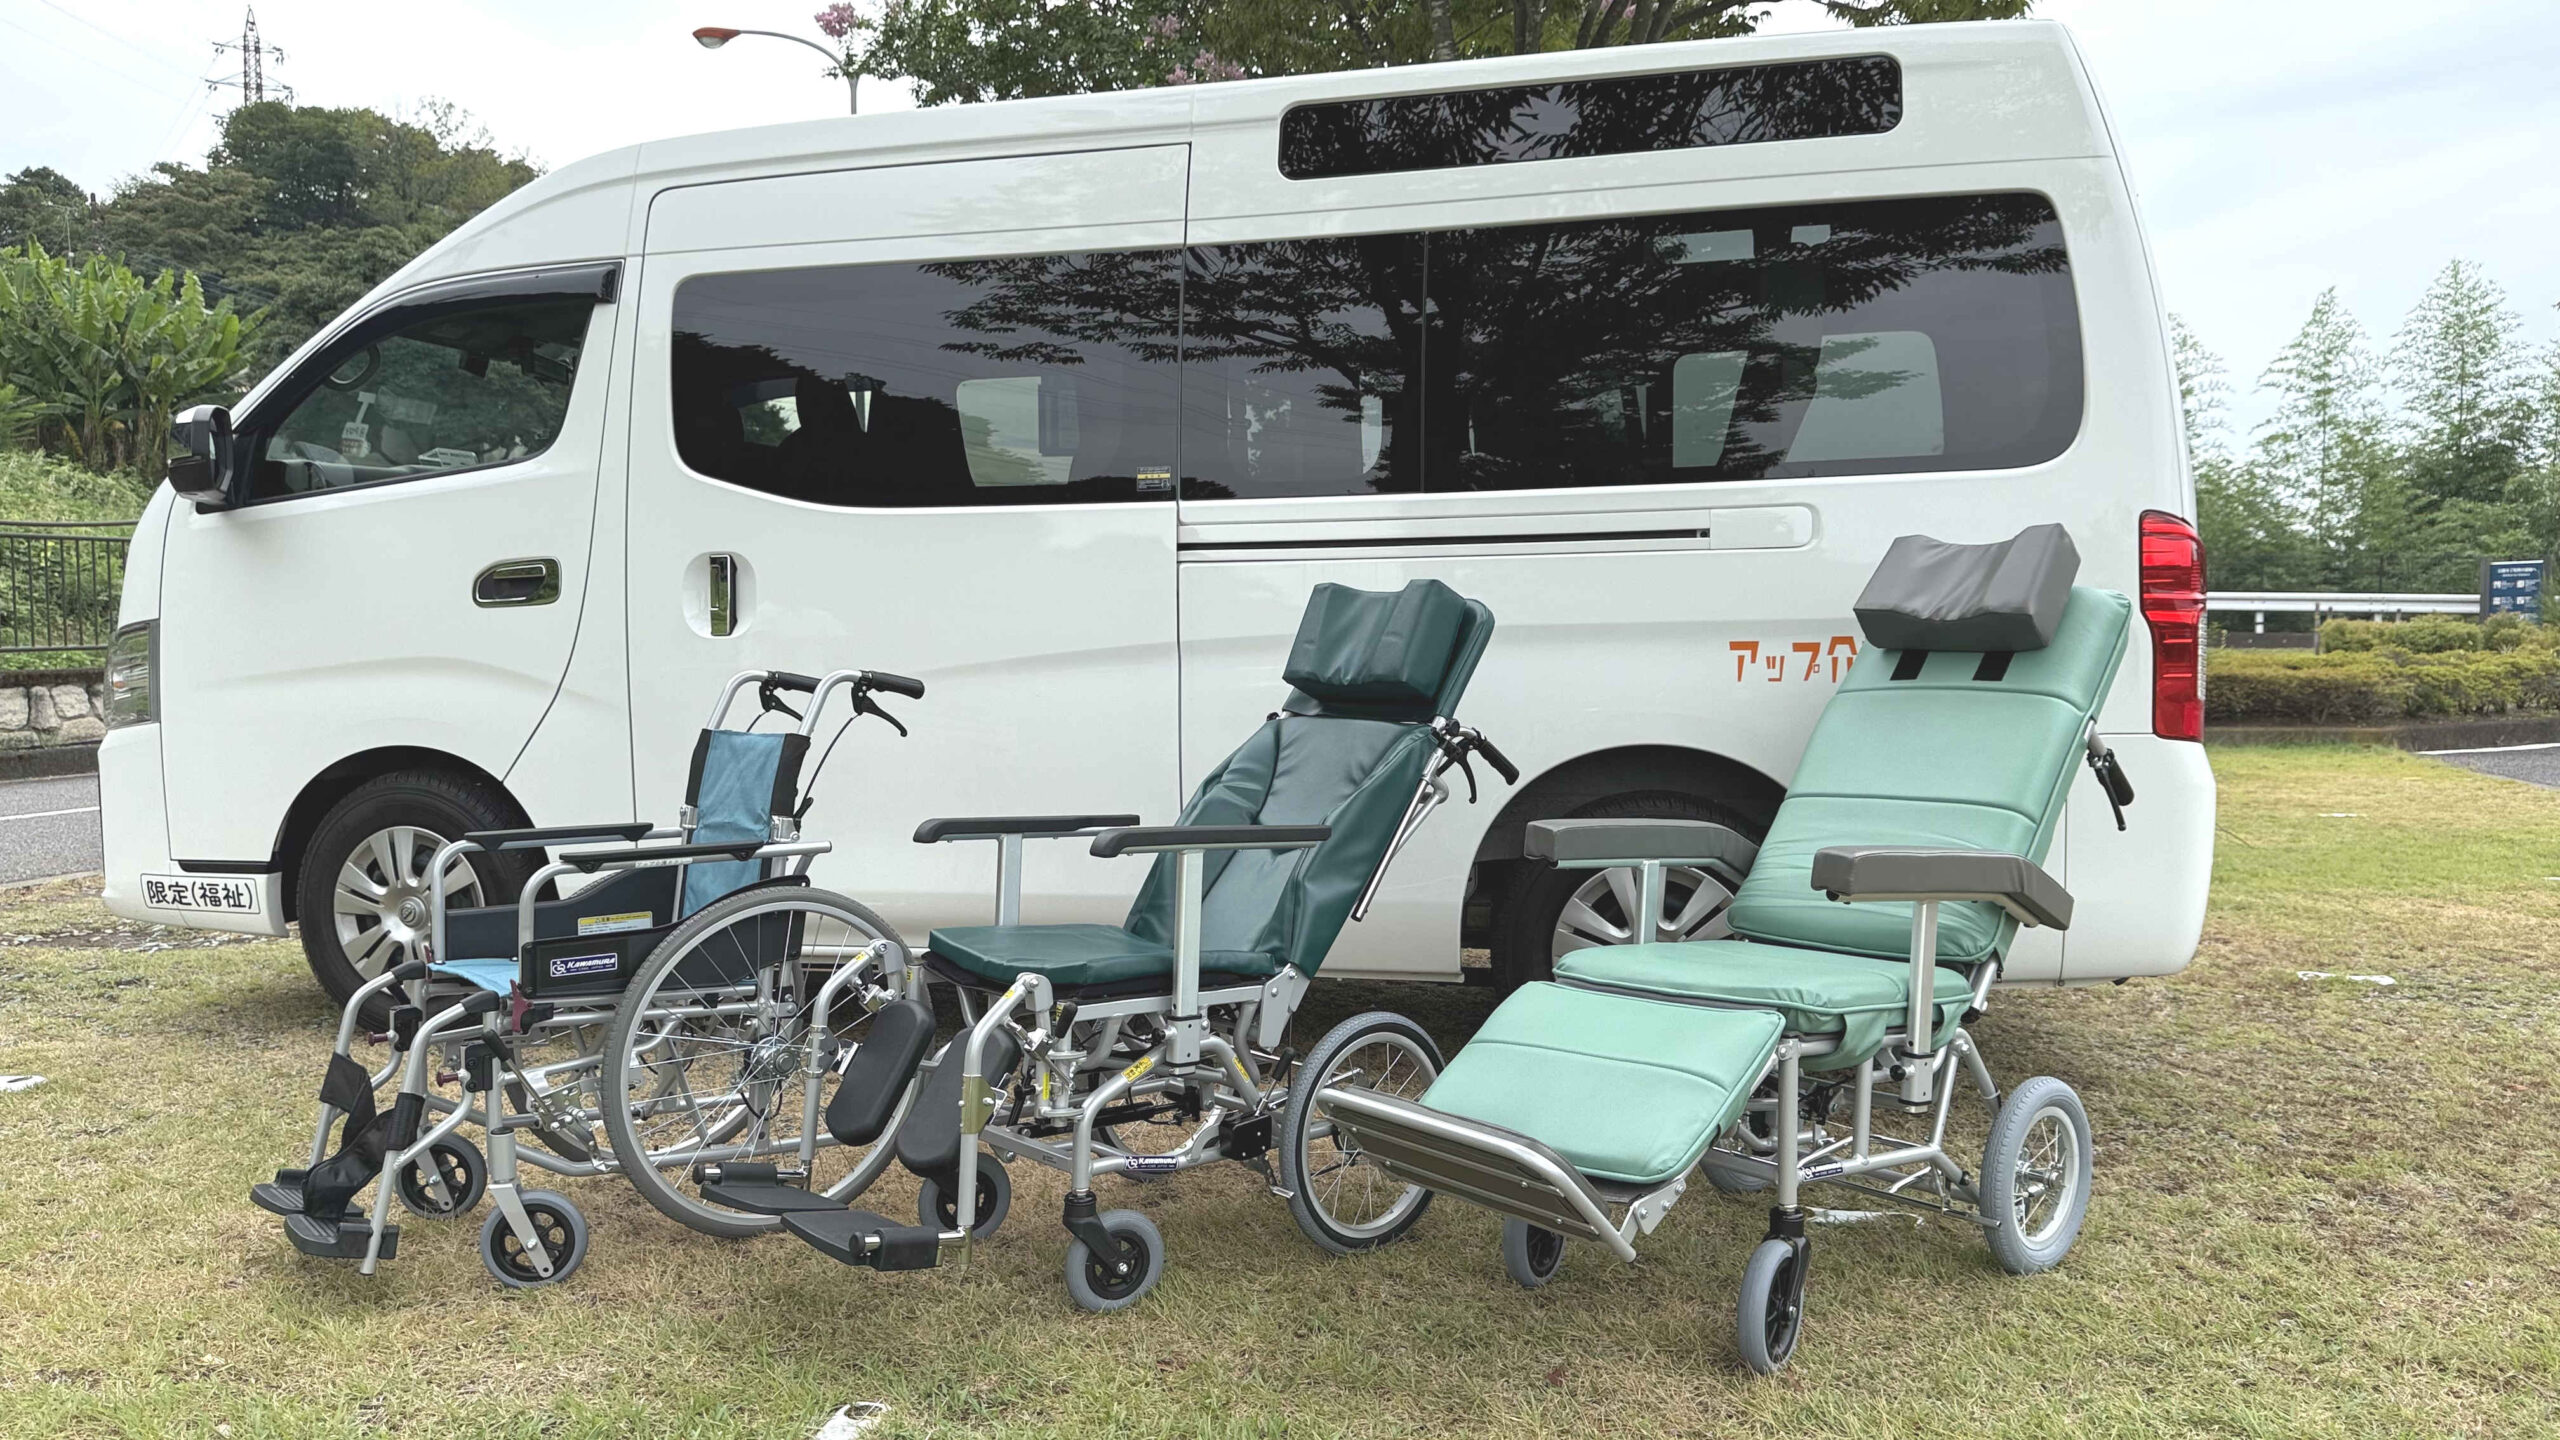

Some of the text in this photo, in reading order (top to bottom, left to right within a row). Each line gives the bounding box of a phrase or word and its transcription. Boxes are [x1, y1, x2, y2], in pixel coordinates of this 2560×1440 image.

[1729, 636, 1857, 683] アップ介
[147, 880, 253, 909] 限定(福祉)
